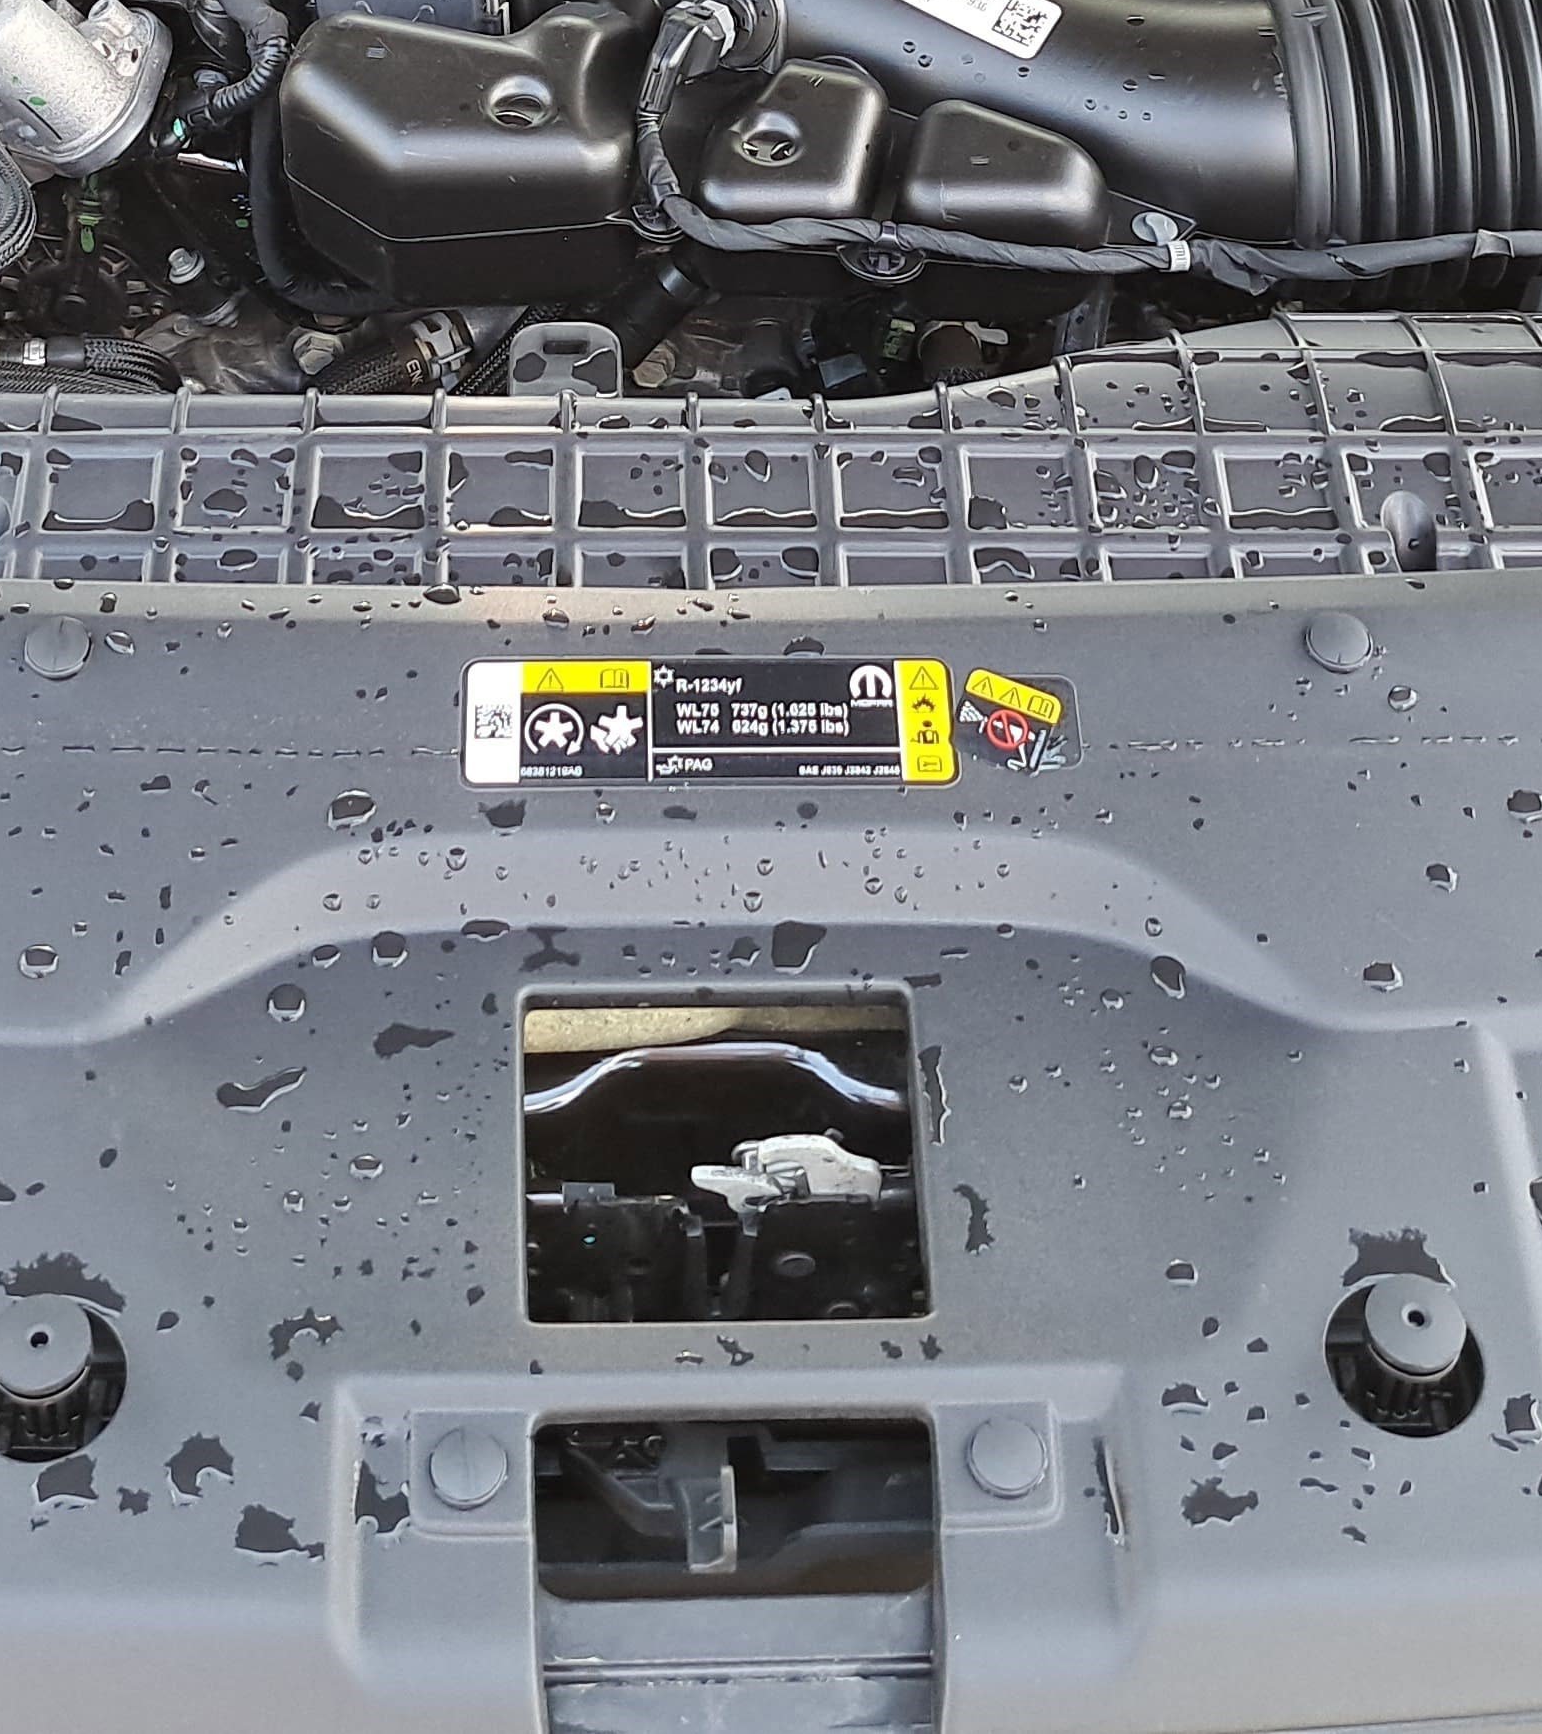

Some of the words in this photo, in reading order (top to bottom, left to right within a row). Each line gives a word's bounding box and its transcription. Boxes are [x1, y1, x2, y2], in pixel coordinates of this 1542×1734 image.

[675, 677, 743, 696] R-1234yf
[731, 703, 768, 719] 737g
[676, 720, 720, 734] WL74
[684, 758, 713, 771] PAG
